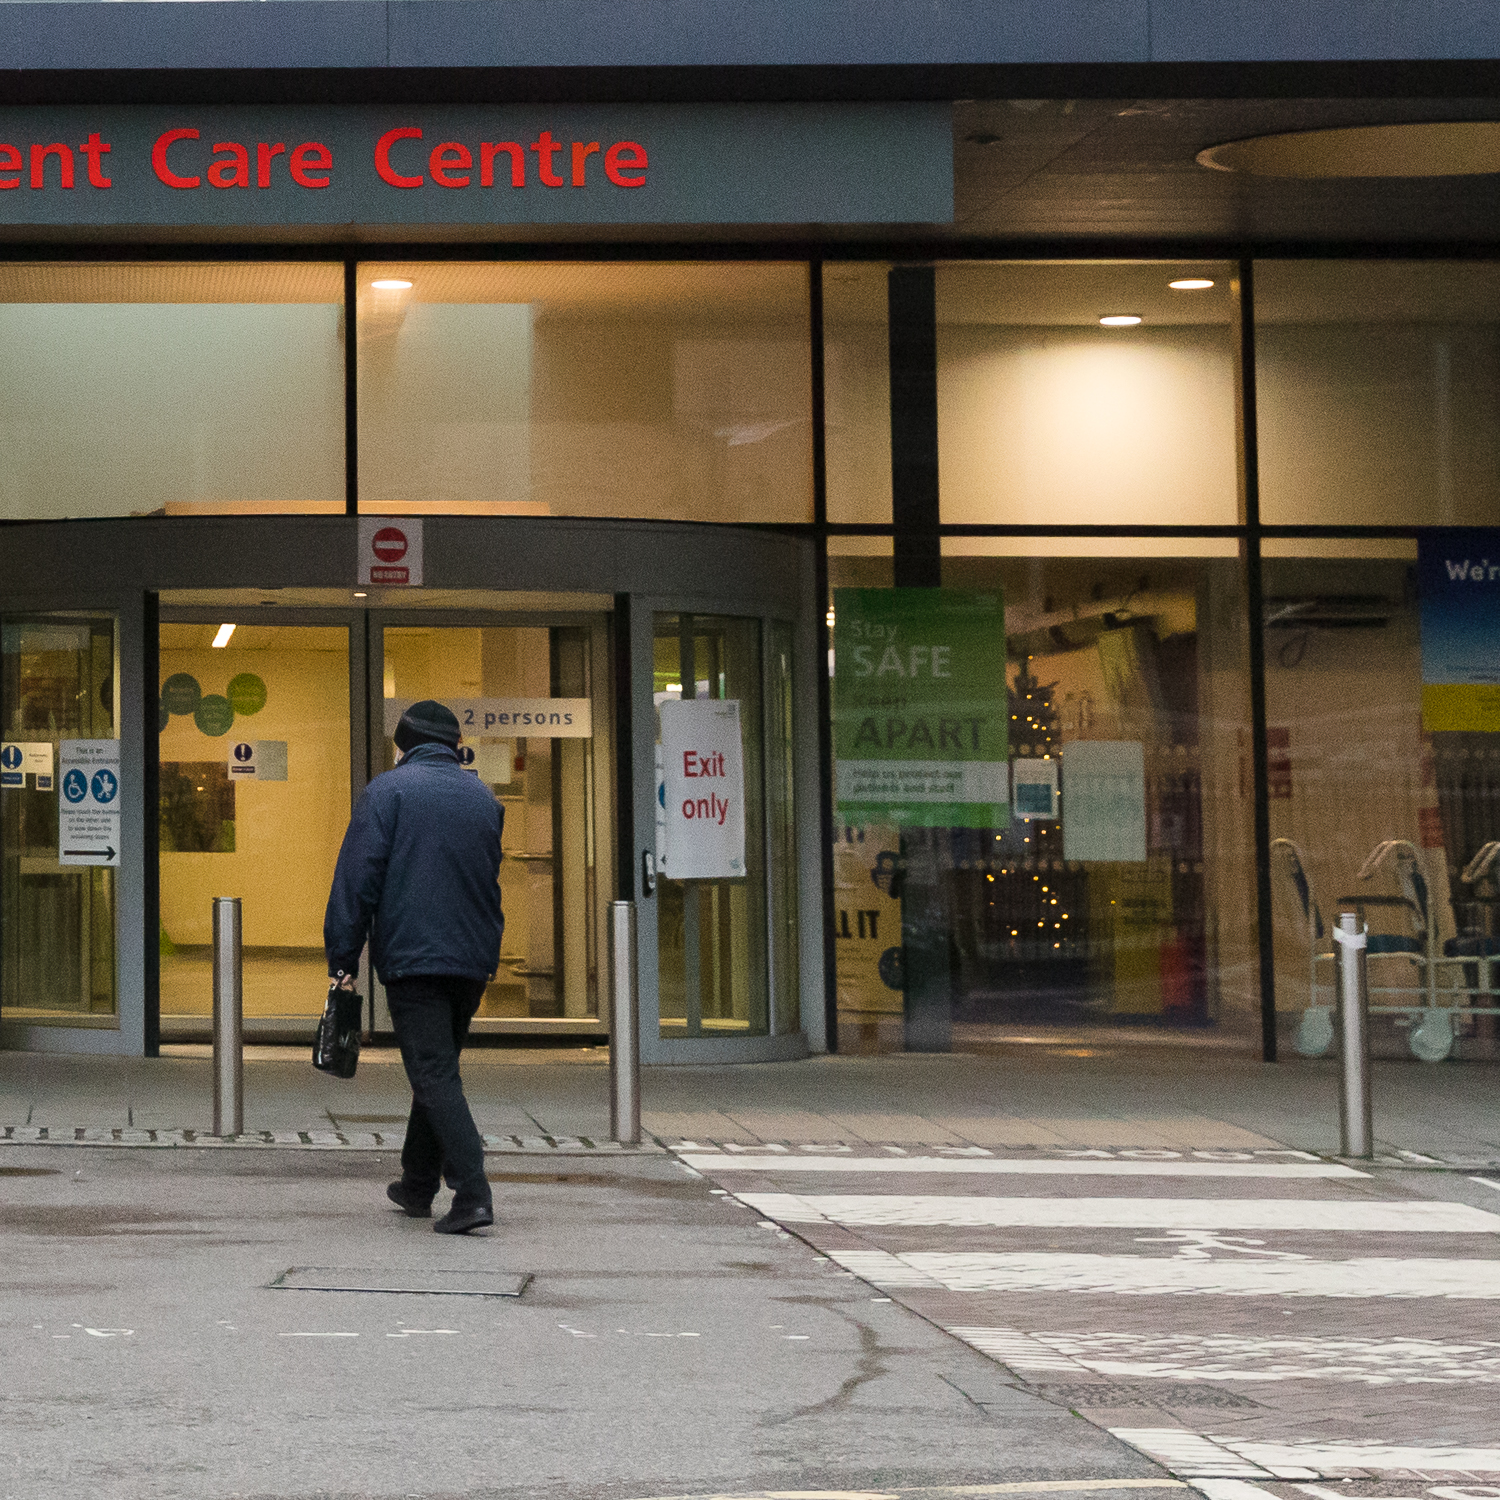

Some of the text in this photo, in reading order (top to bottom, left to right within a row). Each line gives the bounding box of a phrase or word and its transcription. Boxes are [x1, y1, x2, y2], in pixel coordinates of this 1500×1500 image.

[151, 128, 333, 189] Care
[374, 127, 649, 188] Centre
[1446, 558, 1500, 581] We'r
[850, 620, 898, 643] Stay
[853, 645, 951, 678] SAFE
[464, 709, 573, 729] 2 persons
[854, 717, 987, 750] APART
[683, 750, 725, 778] Exit
[682, 792, 729, 826] only
